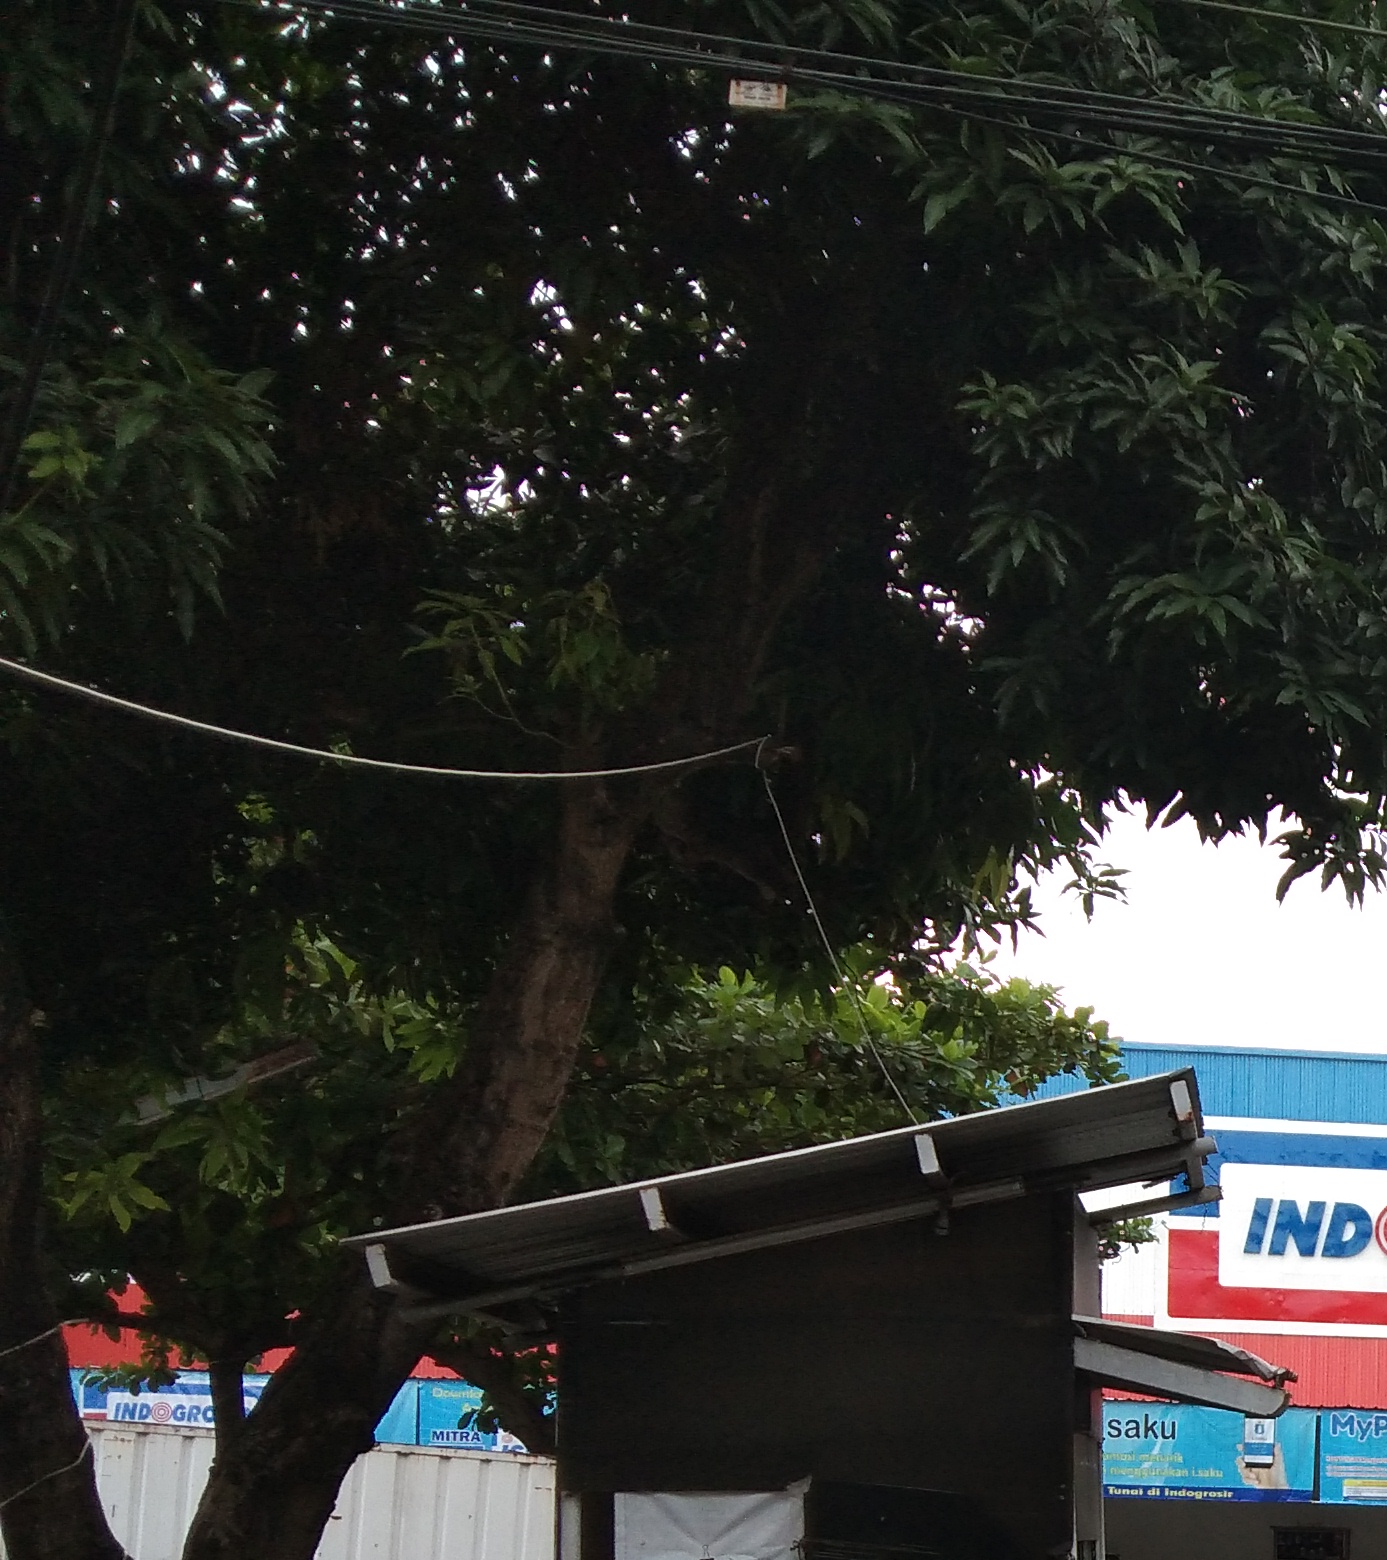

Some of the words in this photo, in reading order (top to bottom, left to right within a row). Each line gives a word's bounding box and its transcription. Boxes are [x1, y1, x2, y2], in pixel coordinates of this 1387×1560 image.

[431, 1431, 481, 1442] MITRA
[1107, 1486, 1143, 1496] Tunai
[1147, 1487, 1160, 1496] di
[1164, 1487, 1234, 1499] Indogrosir
